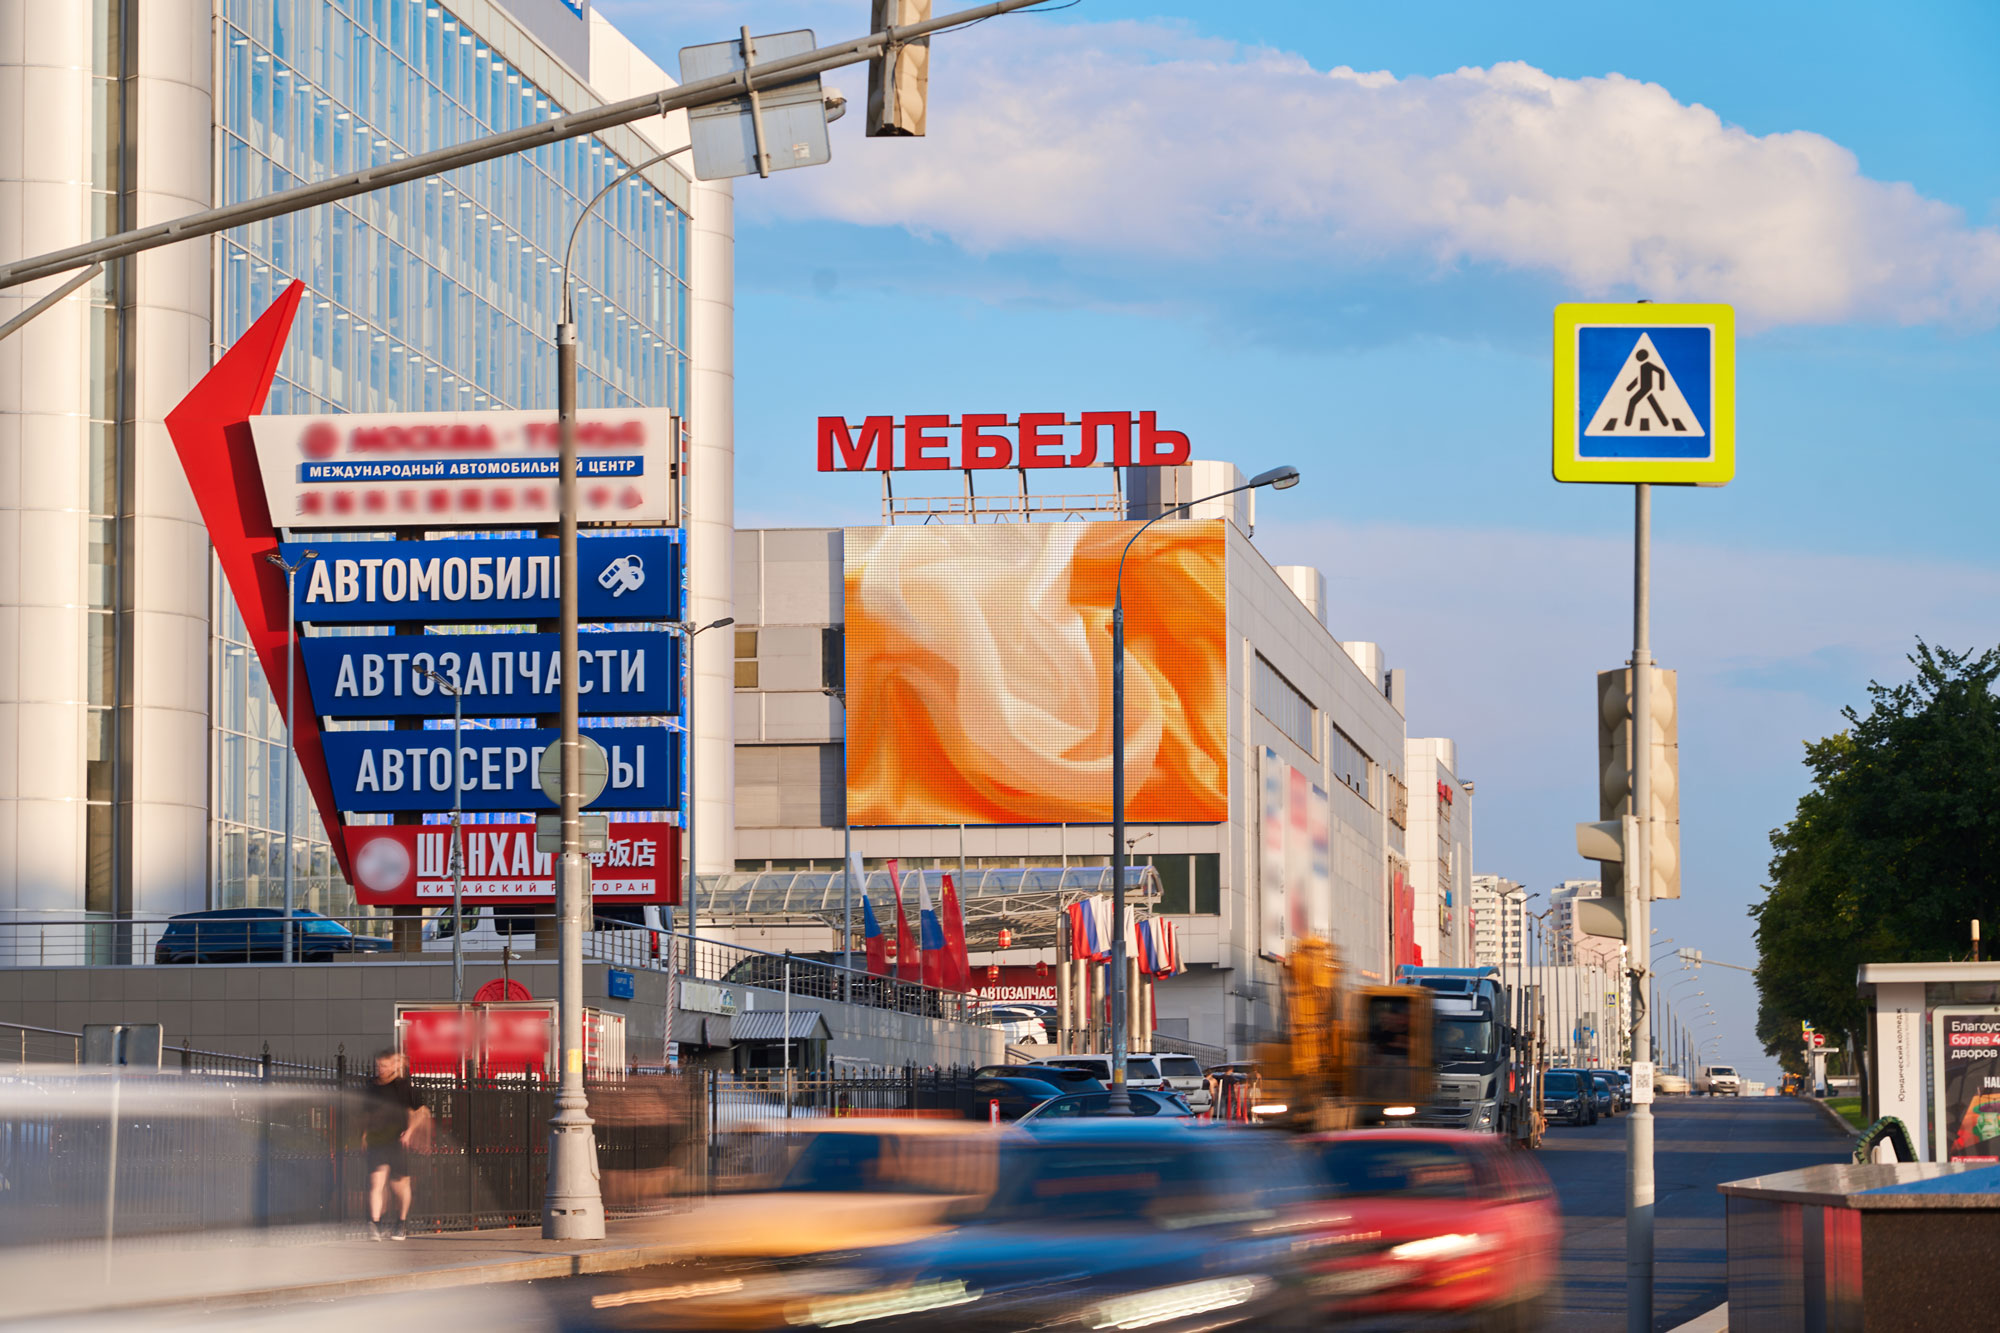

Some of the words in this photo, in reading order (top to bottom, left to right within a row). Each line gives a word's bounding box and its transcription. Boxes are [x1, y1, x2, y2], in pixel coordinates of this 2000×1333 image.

[817, 410, 1192, 472] МЕБЕЛЬ
[309, 461, 445, 478] МЕЖДУНАРОДНЫЙ
[450, 459, 583, 476] АВТОМОБИЛЬНЙ
[588, 460, 636, 474] ЦЕНТР
[306, 555, 561, 603] АВТОМОБИЛ
[334, 649, 646, 697] АВТОЗАПЧАСТИ
[355, 745, 645, 793] АВТОСЕРЫ
[423, 882, 537, 893] КИТАЙСКИЙ
[551, 882, 649, 892] РТОРАН
[1951, 1021, 2000, 1033] Благоус
[1951, 1033, 1990, 1045] более
[1951, 1049, 1998, 1060] дворов
[1897, 1045, 1906, 1102] Юридический
